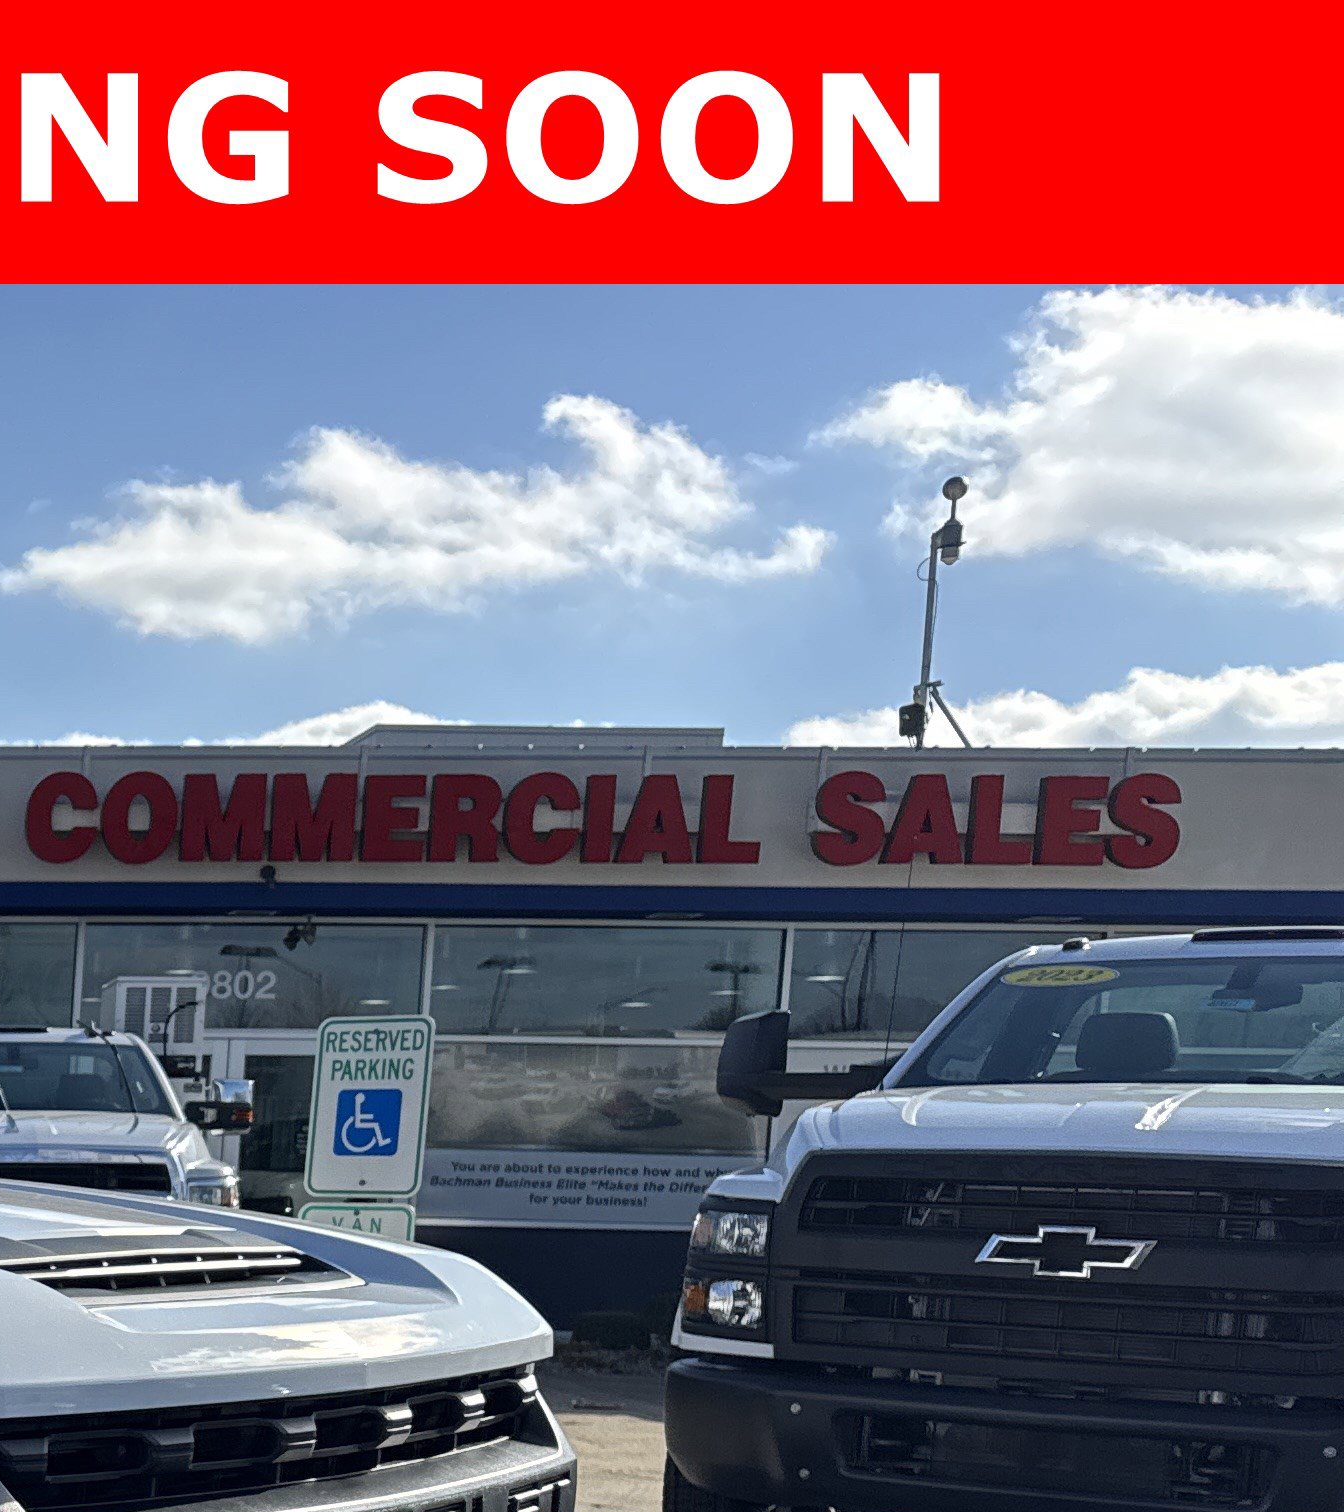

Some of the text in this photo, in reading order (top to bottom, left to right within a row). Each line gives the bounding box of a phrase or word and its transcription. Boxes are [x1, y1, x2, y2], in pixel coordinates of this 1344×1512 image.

[26, 771, 760, 865] COMMERCIAL
[811, 771, 1182, 869] SALES
[325, 1028, 425, 1053] RESERVED
[330, 1058, 416, 1082] PARKING
[450, 1160, 476, 1172] You
[479, 1162, 501, 1173] are
[504, 1163, 544, 1174] about
[547, 1163, 562, 1174] to
[565, 1165, 639, 1177] experience
[643, 1165, 671, 1177] how
[675, 1166, 701, 1178] and
[429, 1175, 491, 1187] Bachman
[495, 1176, 552, 1189] Business
[556, 1178, 587, 1190] Elite
[643, 1181, 665, 1193] the
[669, 1182, 707, 1194] Differ
[528, 1192, 648, 1207] for your business!
[331, 1216, 383, 1234] VAN
